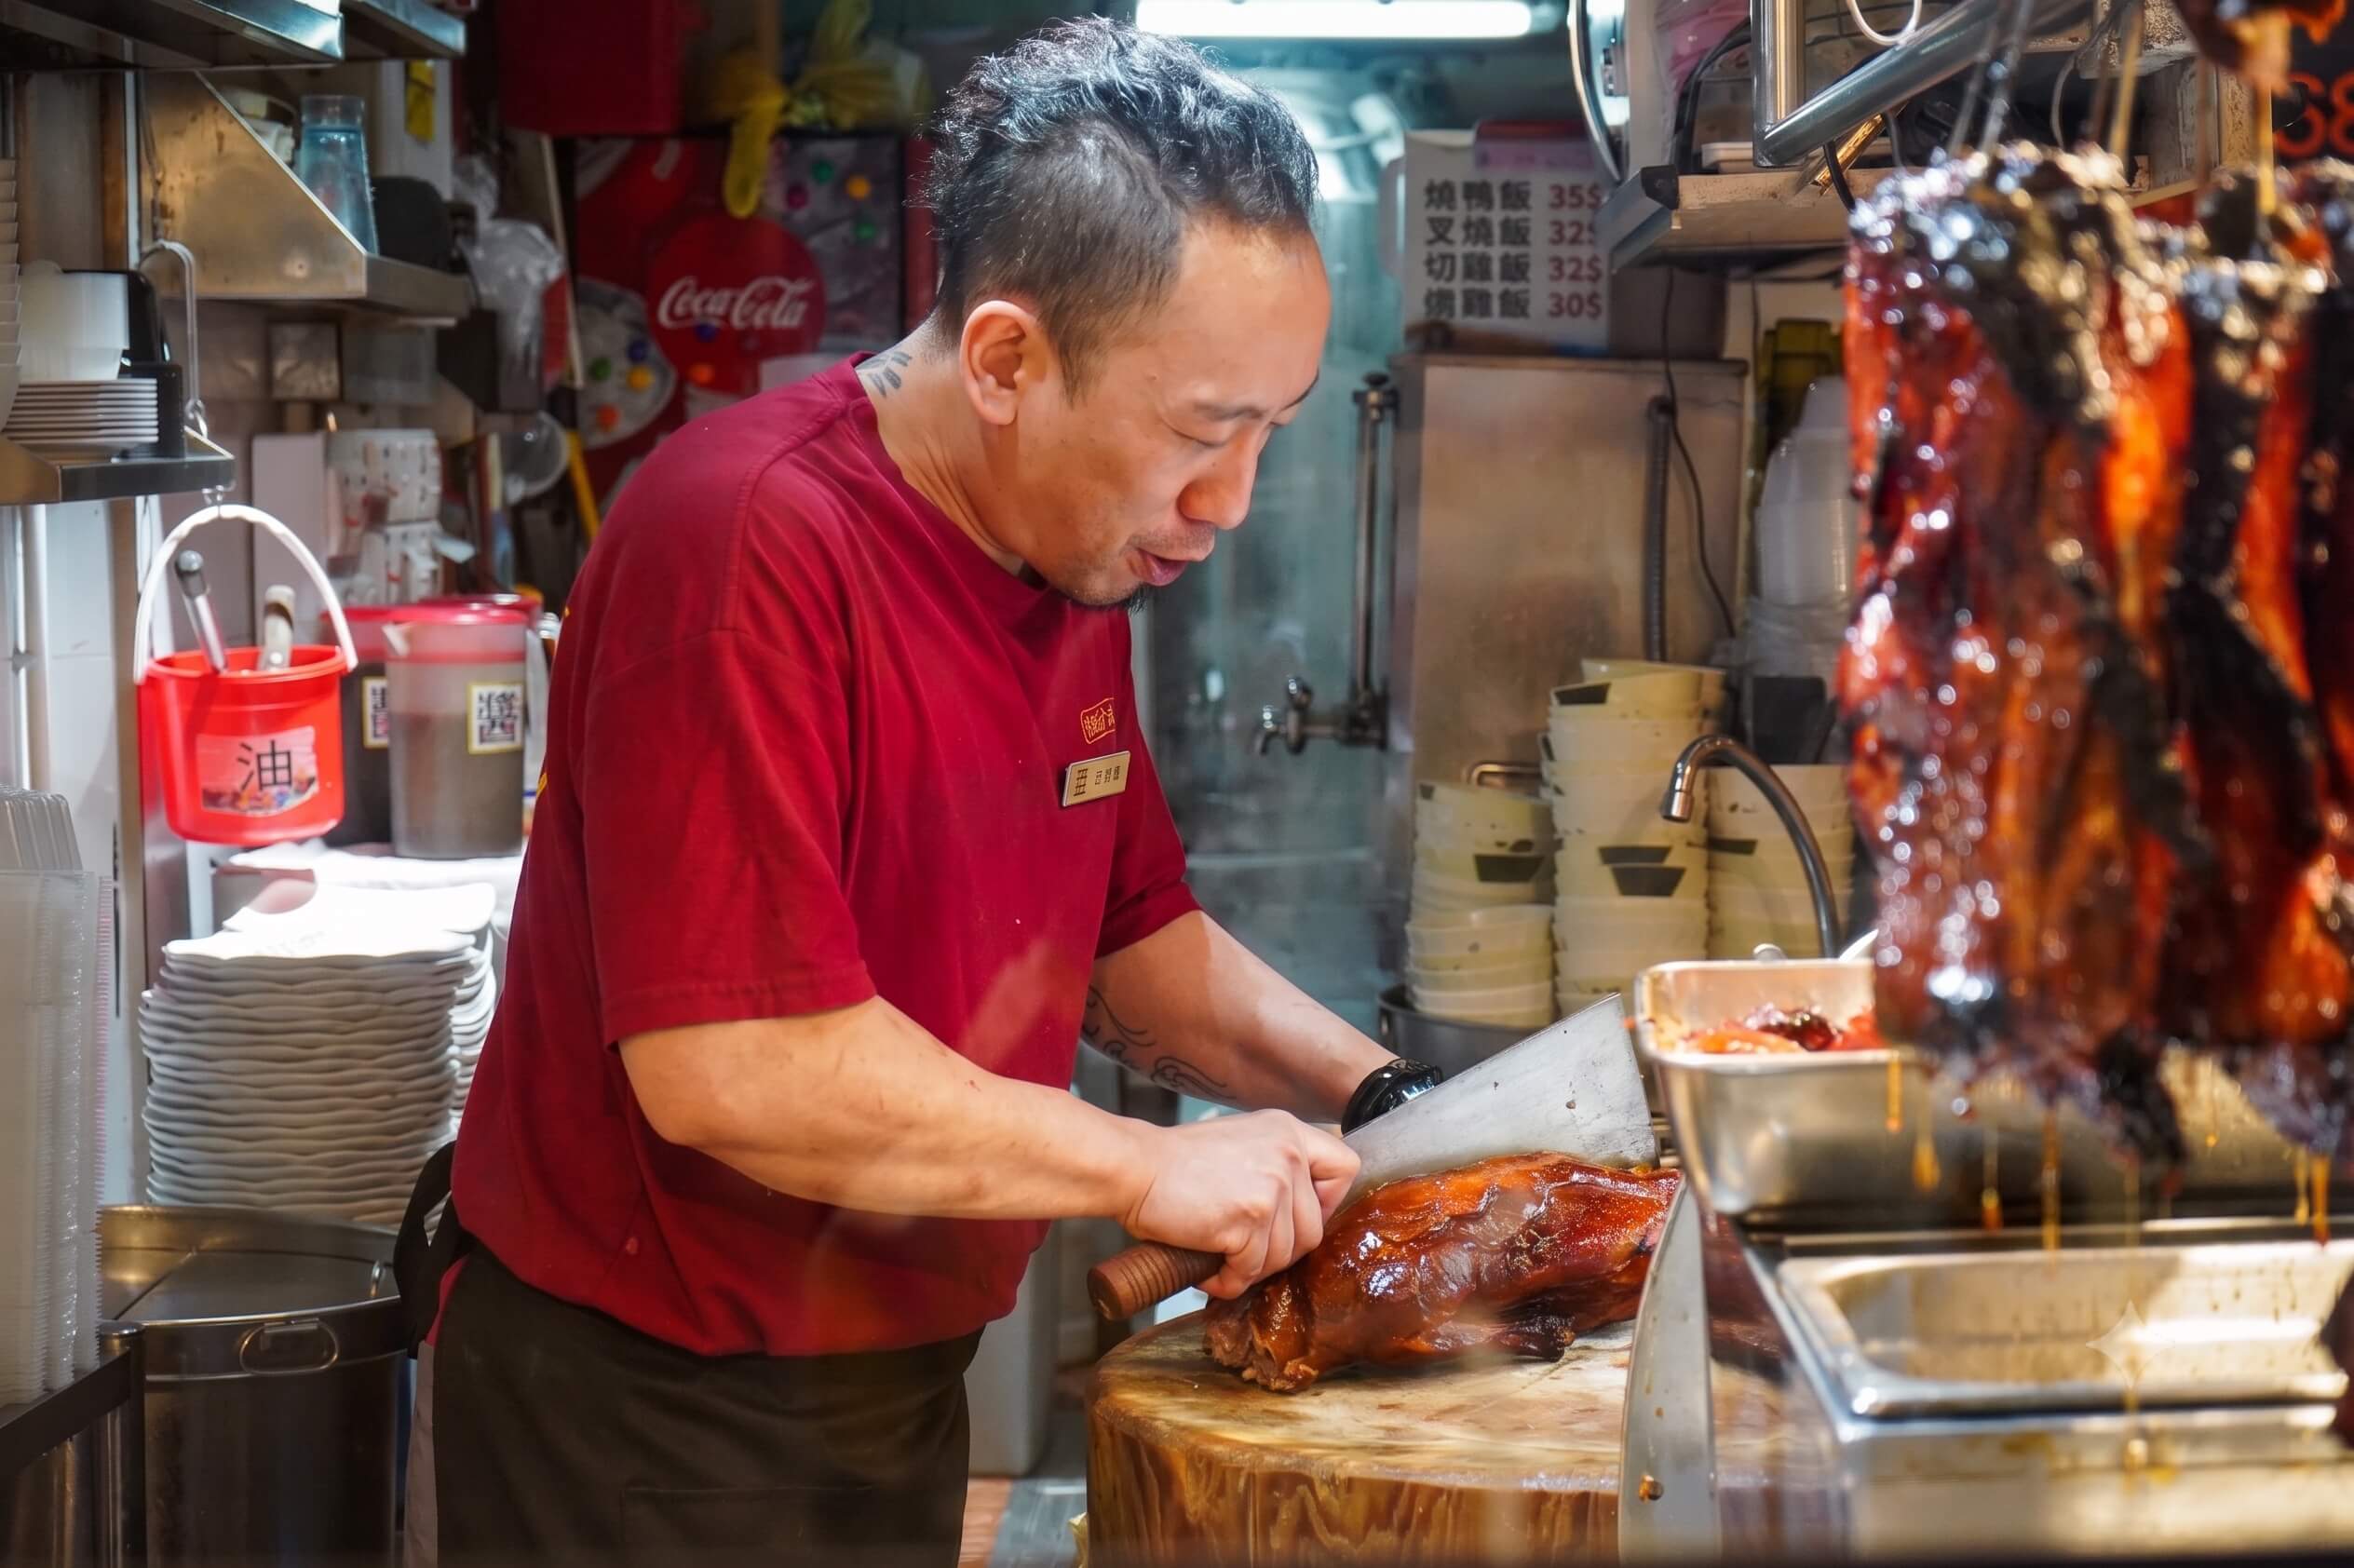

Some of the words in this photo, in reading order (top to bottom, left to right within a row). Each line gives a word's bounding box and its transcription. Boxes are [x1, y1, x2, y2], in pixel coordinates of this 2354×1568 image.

[1549, 182, 1603, 210] 35$
[1426, 216, 1531, 248] 叉燒飯
[1549, 255, 1603, 283] 32$
[1548, 291, 1603, 318] 30$
[237, 739, 292, 791] 油
